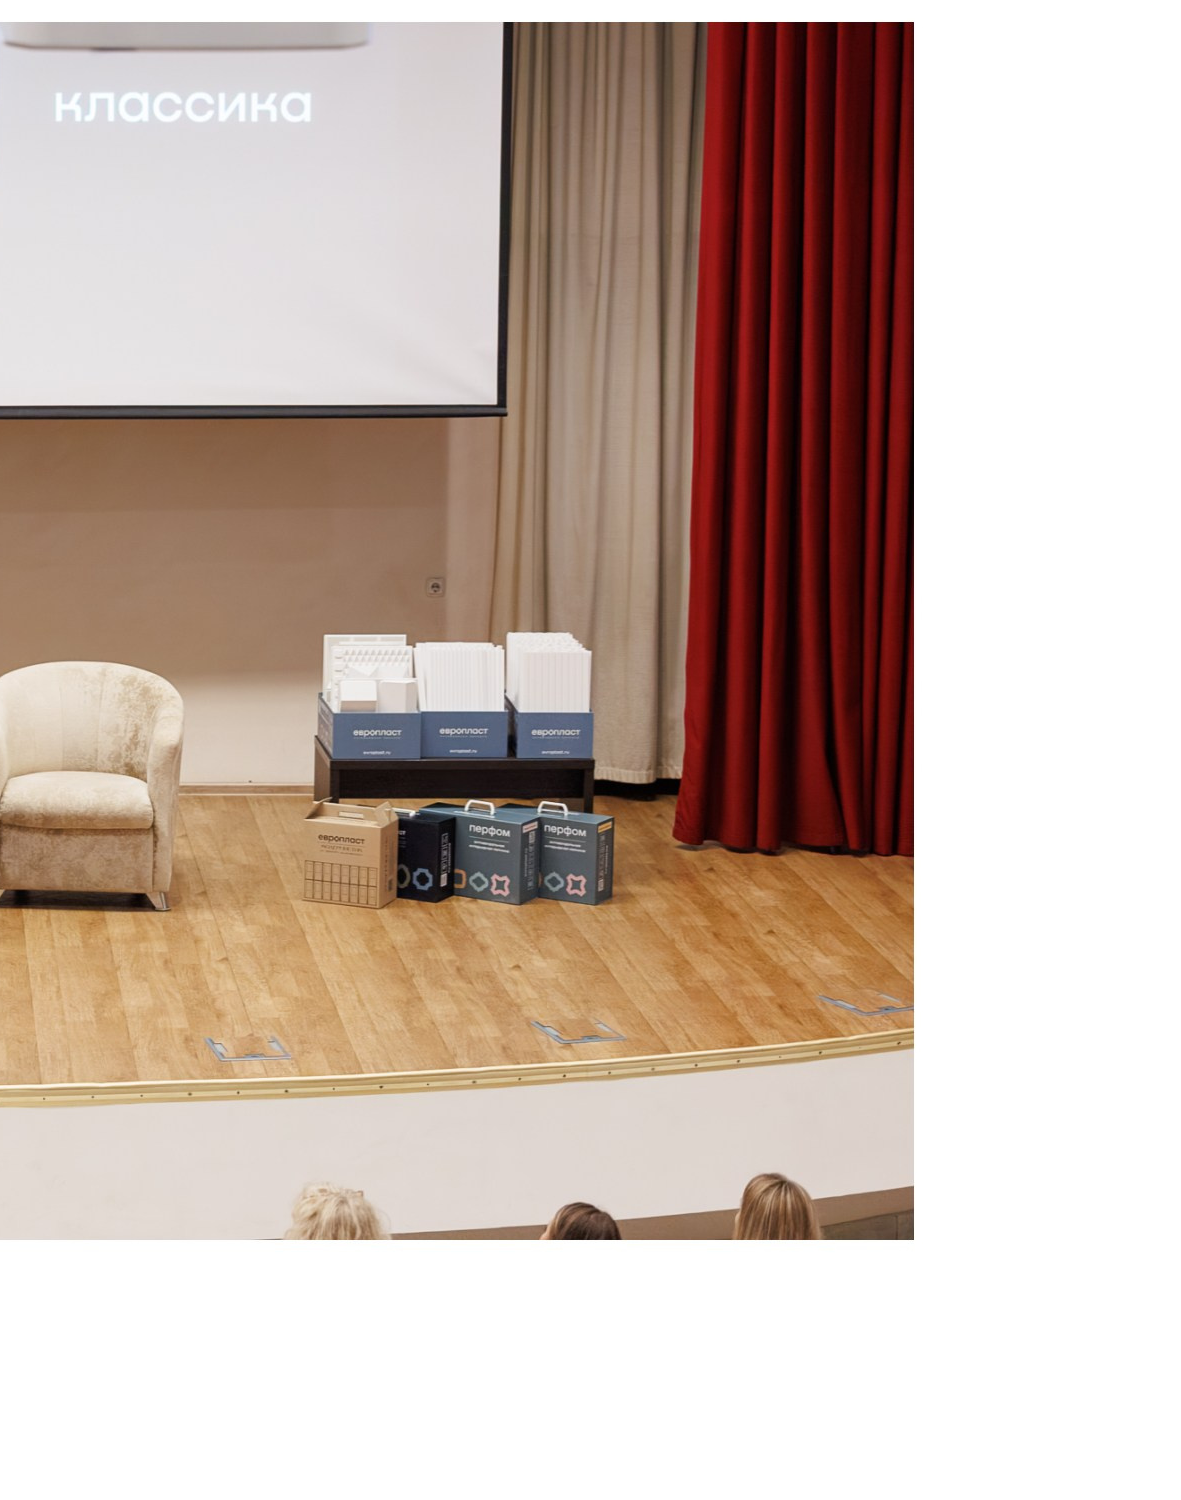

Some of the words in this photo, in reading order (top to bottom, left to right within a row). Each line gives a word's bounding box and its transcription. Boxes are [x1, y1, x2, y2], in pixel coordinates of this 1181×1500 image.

[54, 91, 313, 123] классика
[353, 729, 402, 737] европласт
[439, 727, 489, 736] европласт
[531, 729, 581, 738] европласт
[469, 824, 511, 837] перфом
[544, 824, 587, 837] перфом
[318, 834, 365, 845] европласт
